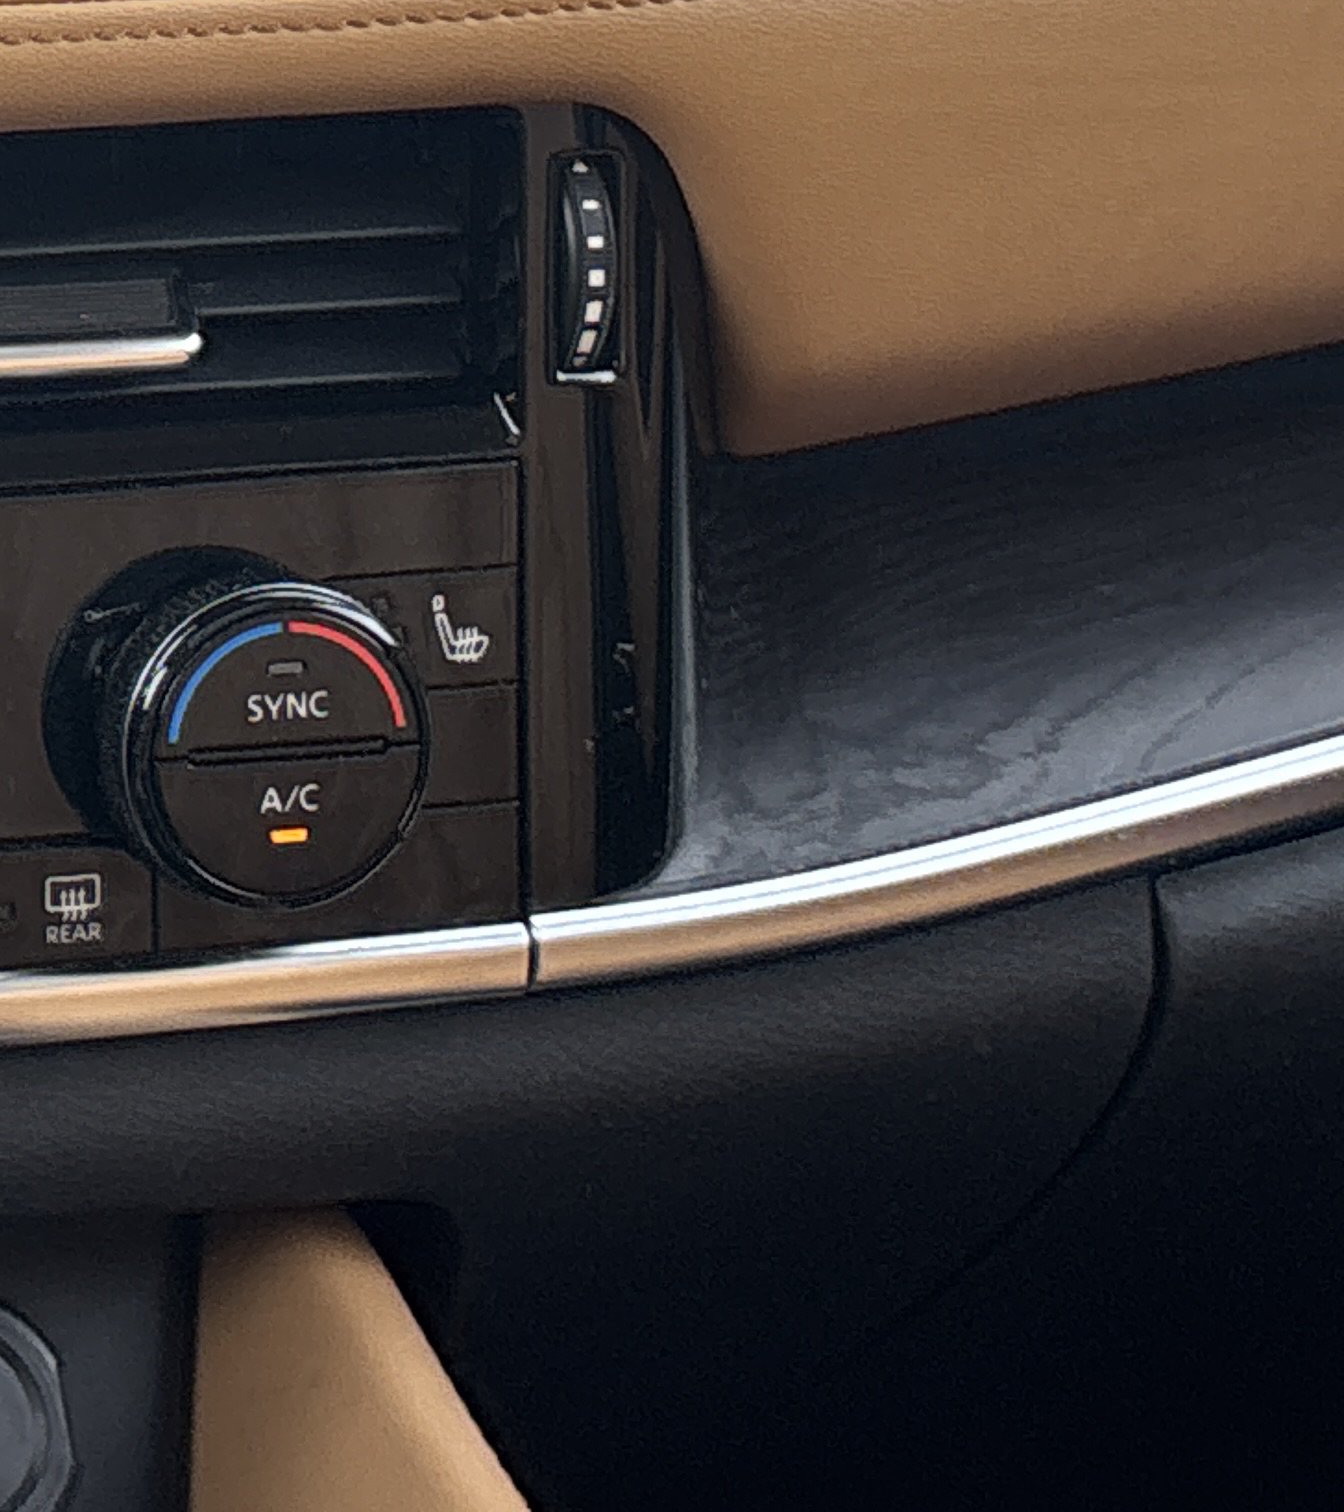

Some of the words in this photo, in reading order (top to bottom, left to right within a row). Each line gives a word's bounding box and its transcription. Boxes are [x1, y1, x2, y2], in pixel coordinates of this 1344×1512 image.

[247, 690, 328, 722] SYNC
[260, 783, 318, 814] A/C
[45, 921, 102, 944] REAR
